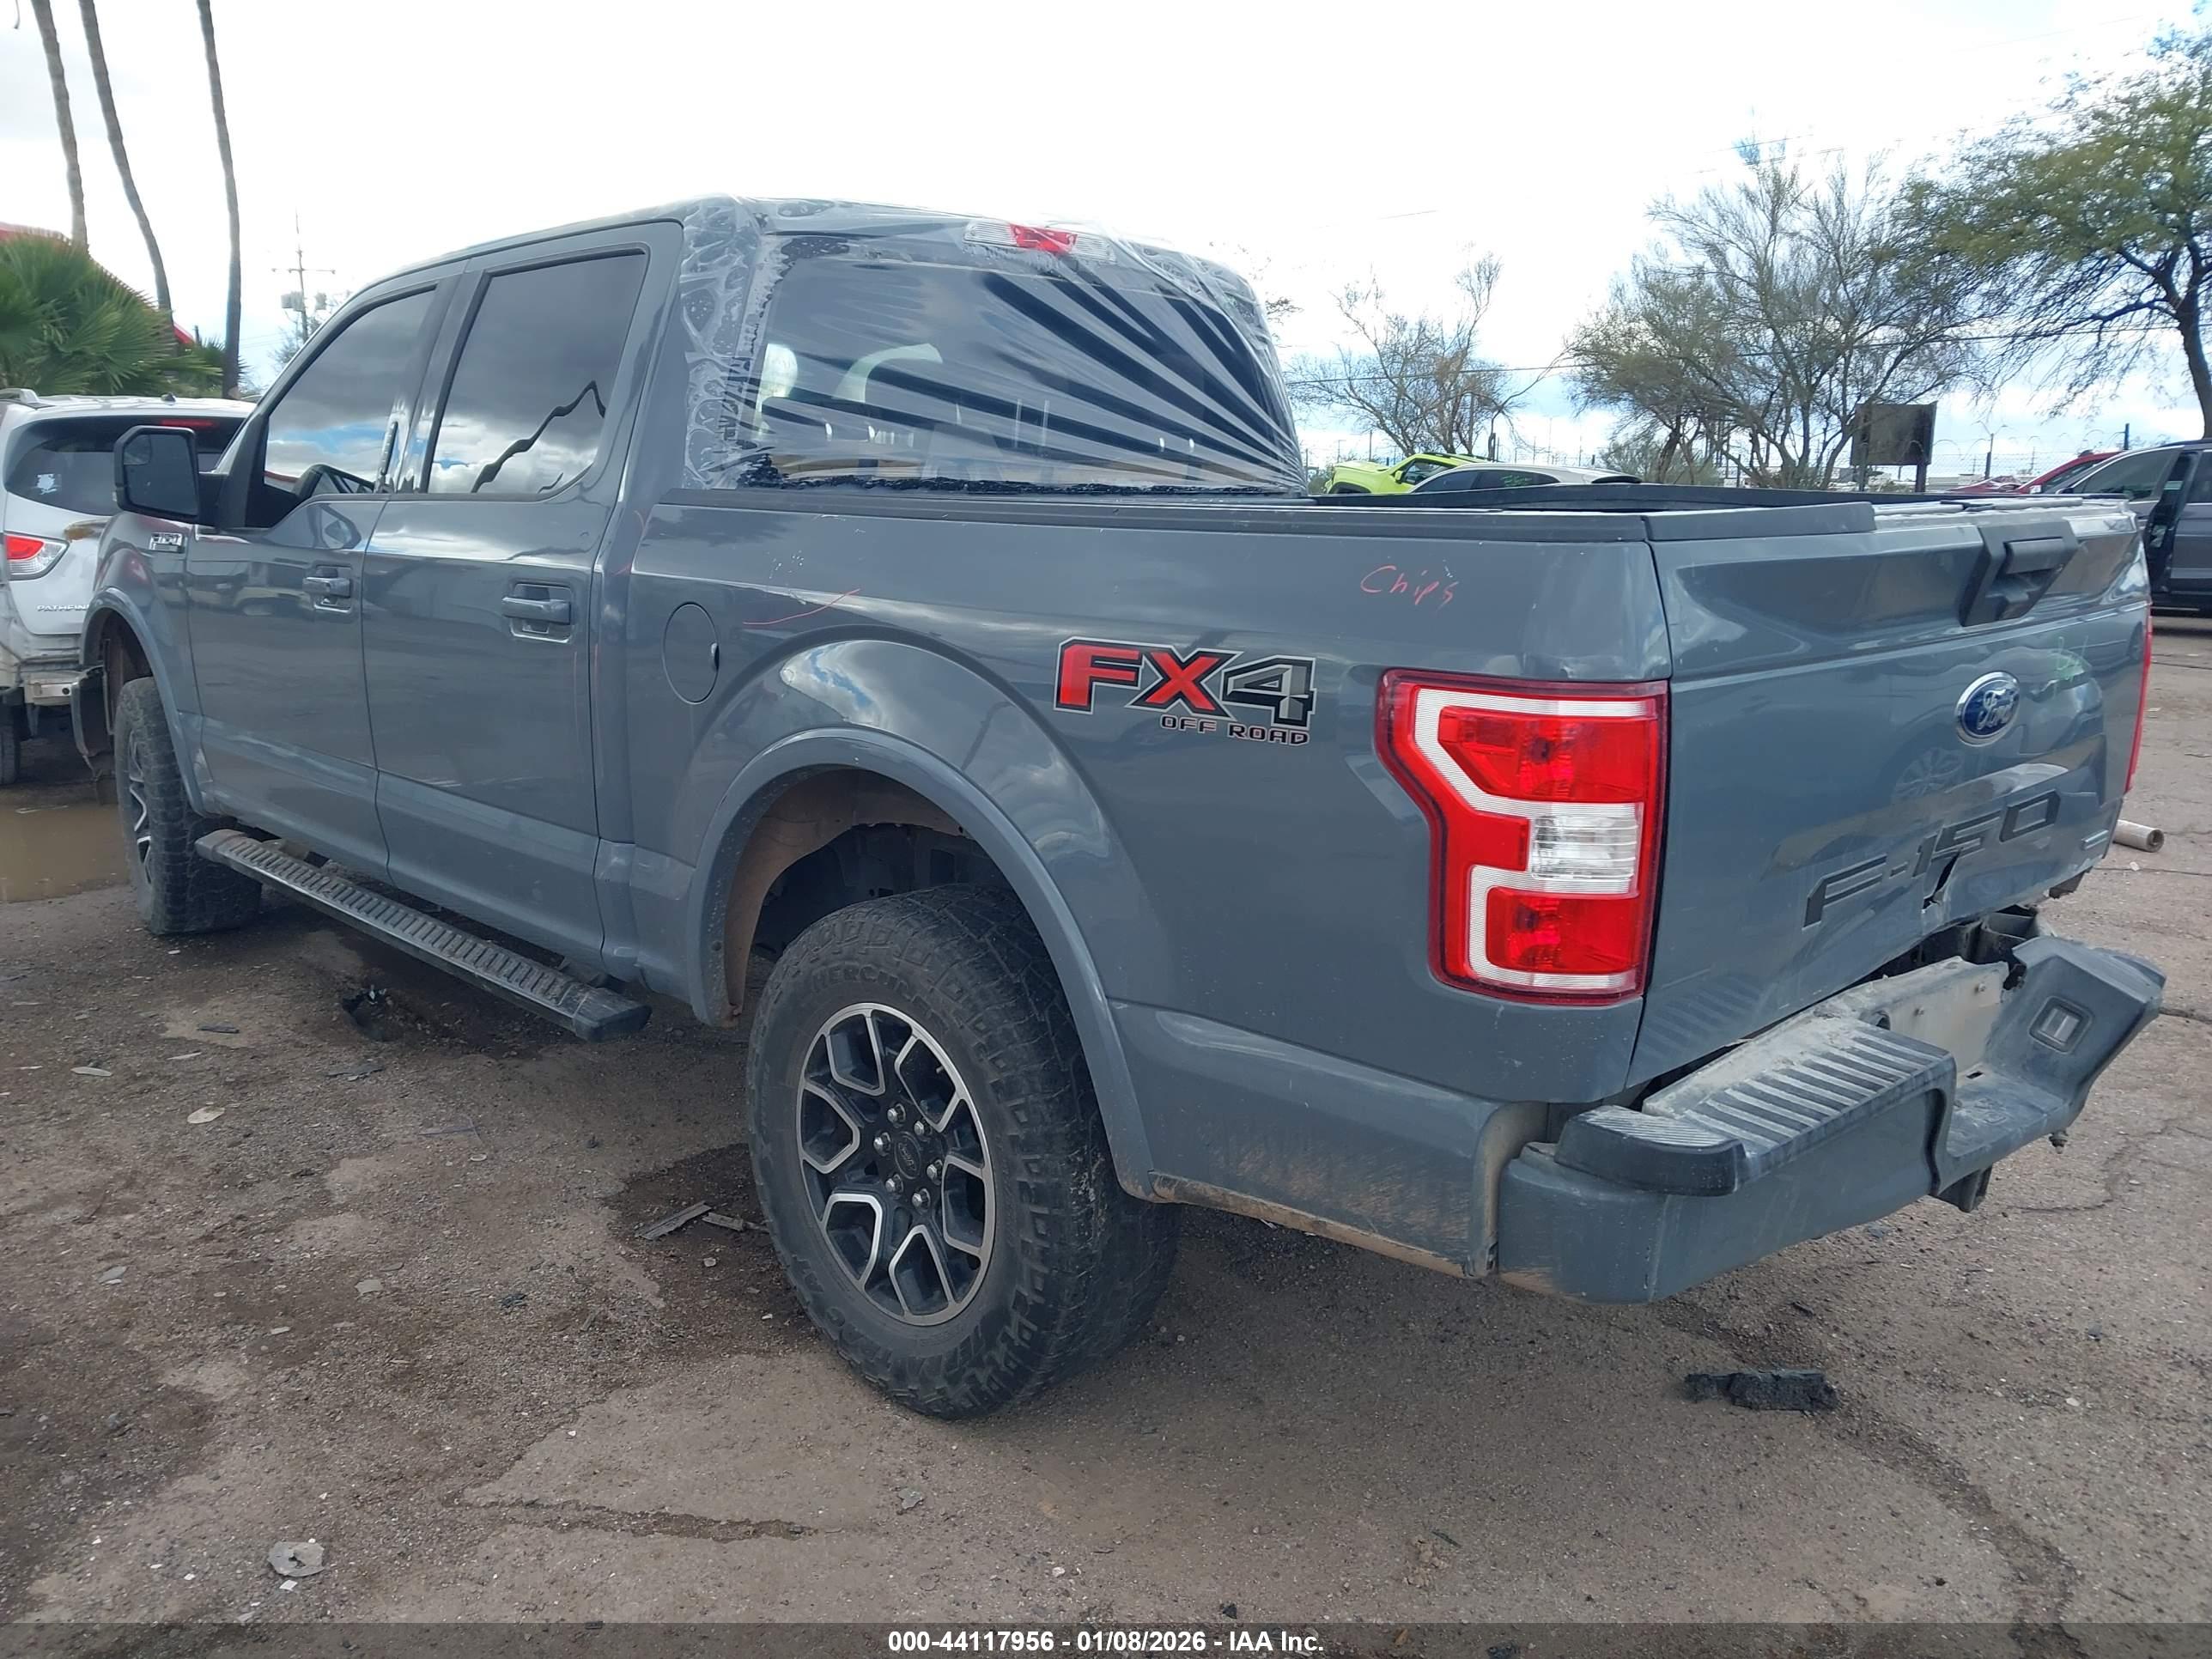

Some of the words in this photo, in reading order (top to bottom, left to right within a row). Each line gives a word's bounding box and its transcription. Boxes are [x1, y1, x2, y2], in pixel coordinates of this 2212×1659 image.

[1359, 564, 1460, 611] Chips
[1053, 635, 1318, 729] FX4
[1160, 714, 1218, 734] OFF
[1227, 722, 1310, 747] ROAD
[1976, 688, 2019, 730] Ford
